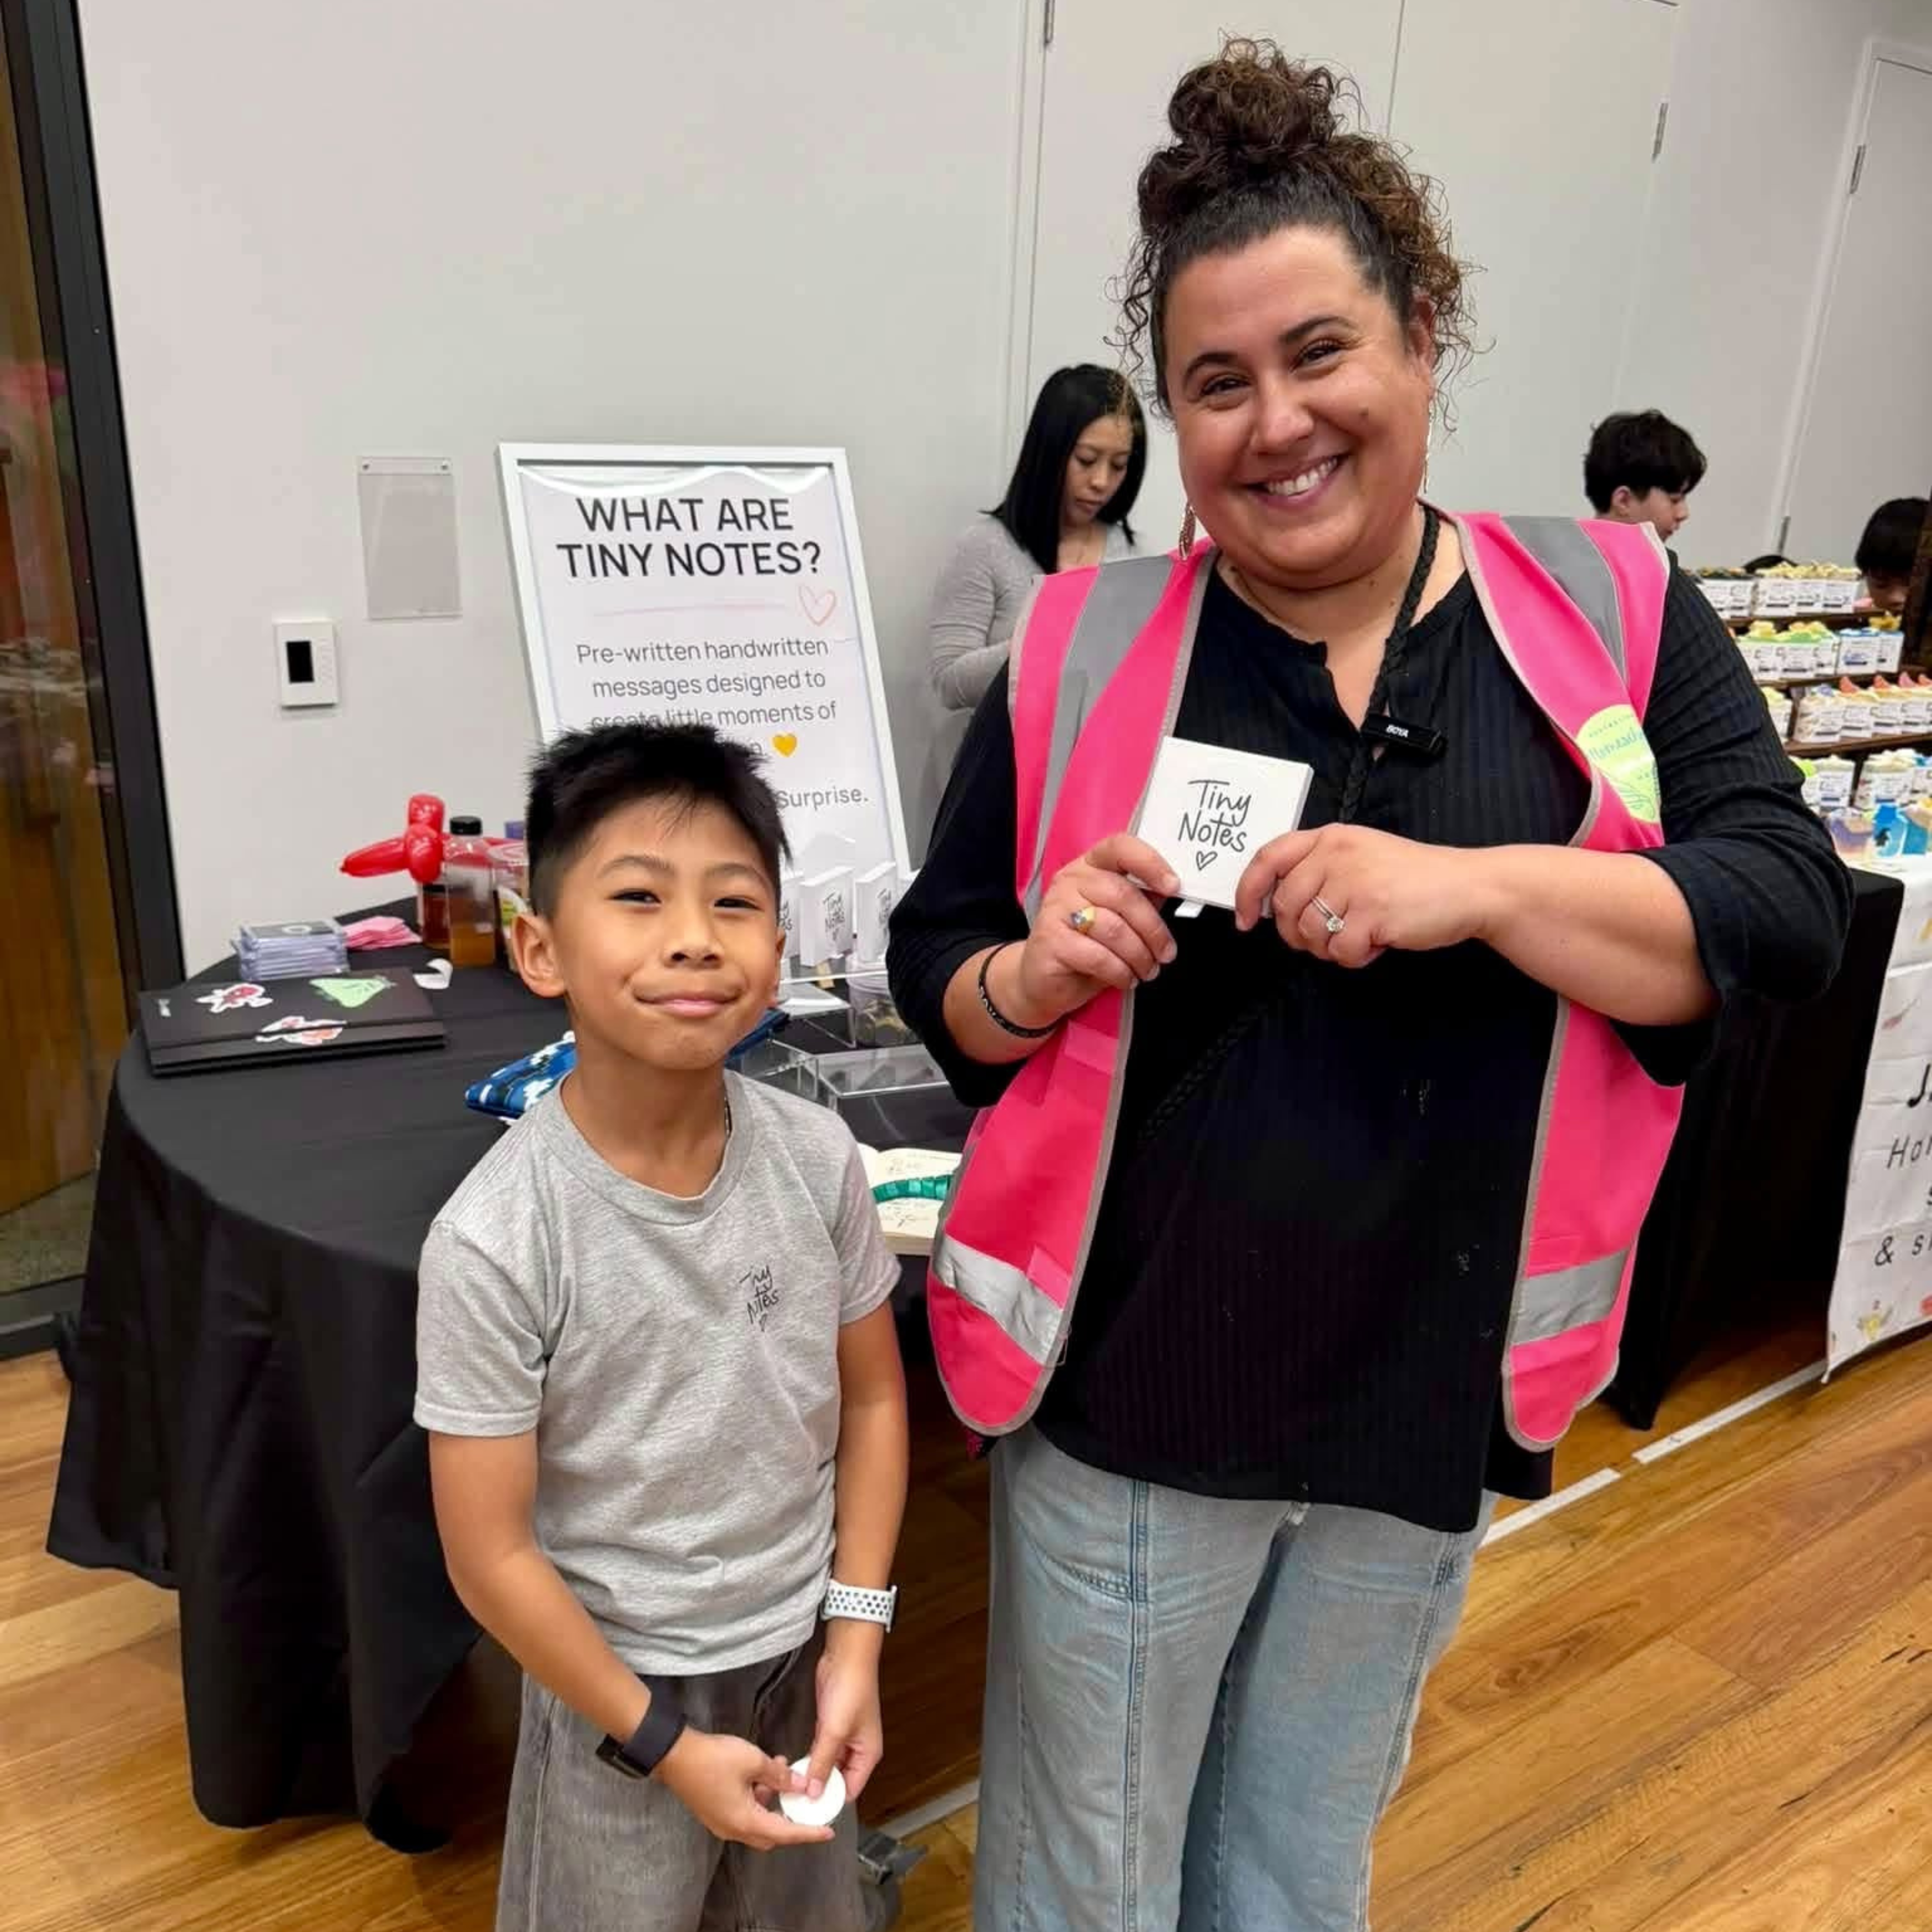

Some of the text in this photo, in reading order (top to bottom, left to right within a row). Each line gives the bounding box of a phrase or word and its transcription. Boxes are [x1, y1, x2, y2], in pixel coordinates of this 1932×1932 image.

[576, 497, 793, 532] WHAT ARE
[556, 541, 821, 577] TINY NOTES?
[576, 637, 829, 664] Pre-written handwritten
[592, 670, 826, 700] messages designed to
[718, 704, 814, 725] moments
[817, 700, 837, 719] of
[774, 786, 868, 811] Surprise.
[1187, 779, 1251, 827] Tiny
[1177, 809, 1247, 852] Notes
[1875, 1235, 1894, 1266] &
